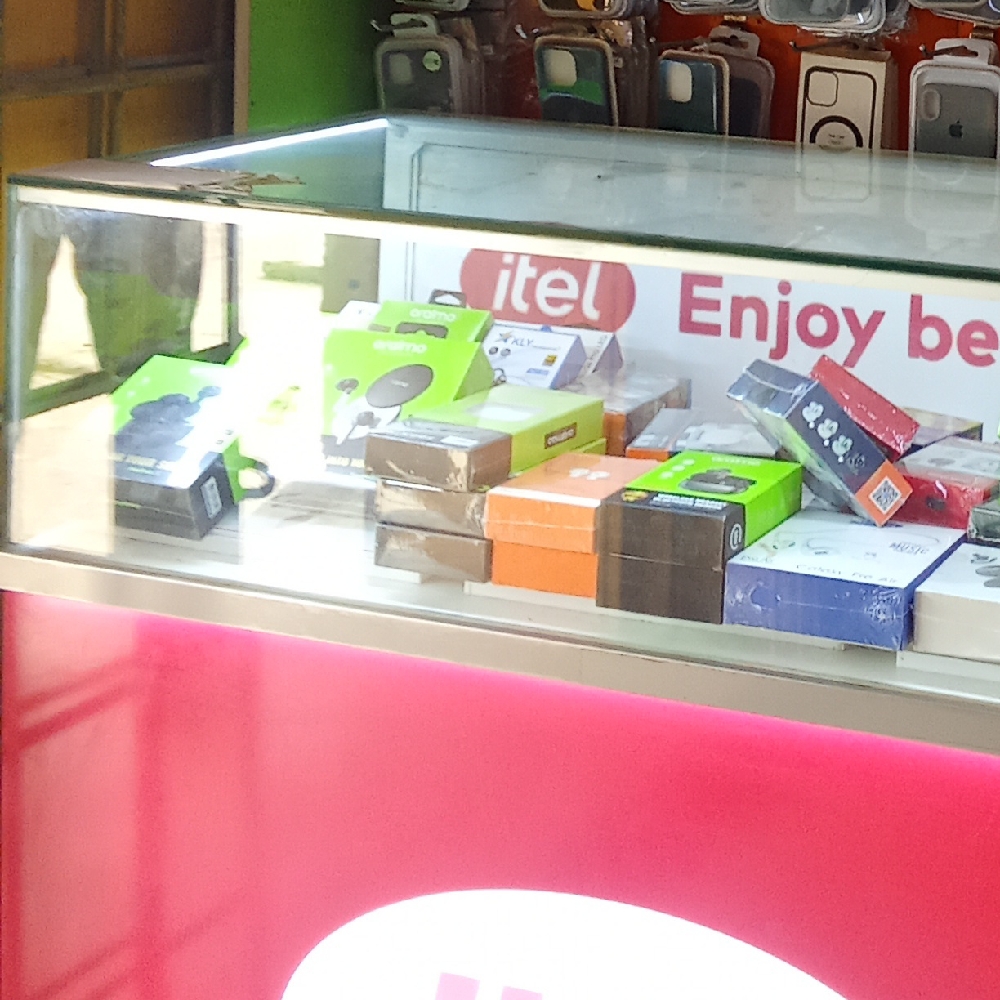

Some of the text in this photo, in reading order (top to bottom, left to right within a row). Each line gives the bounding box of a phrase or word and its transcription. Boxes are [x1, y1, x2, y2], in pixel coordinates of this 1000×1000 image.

[408, 307, 457, 323] oraimo
[492, 253, 602, 321] itel
[679, 272, 887, 368] Enjoy
